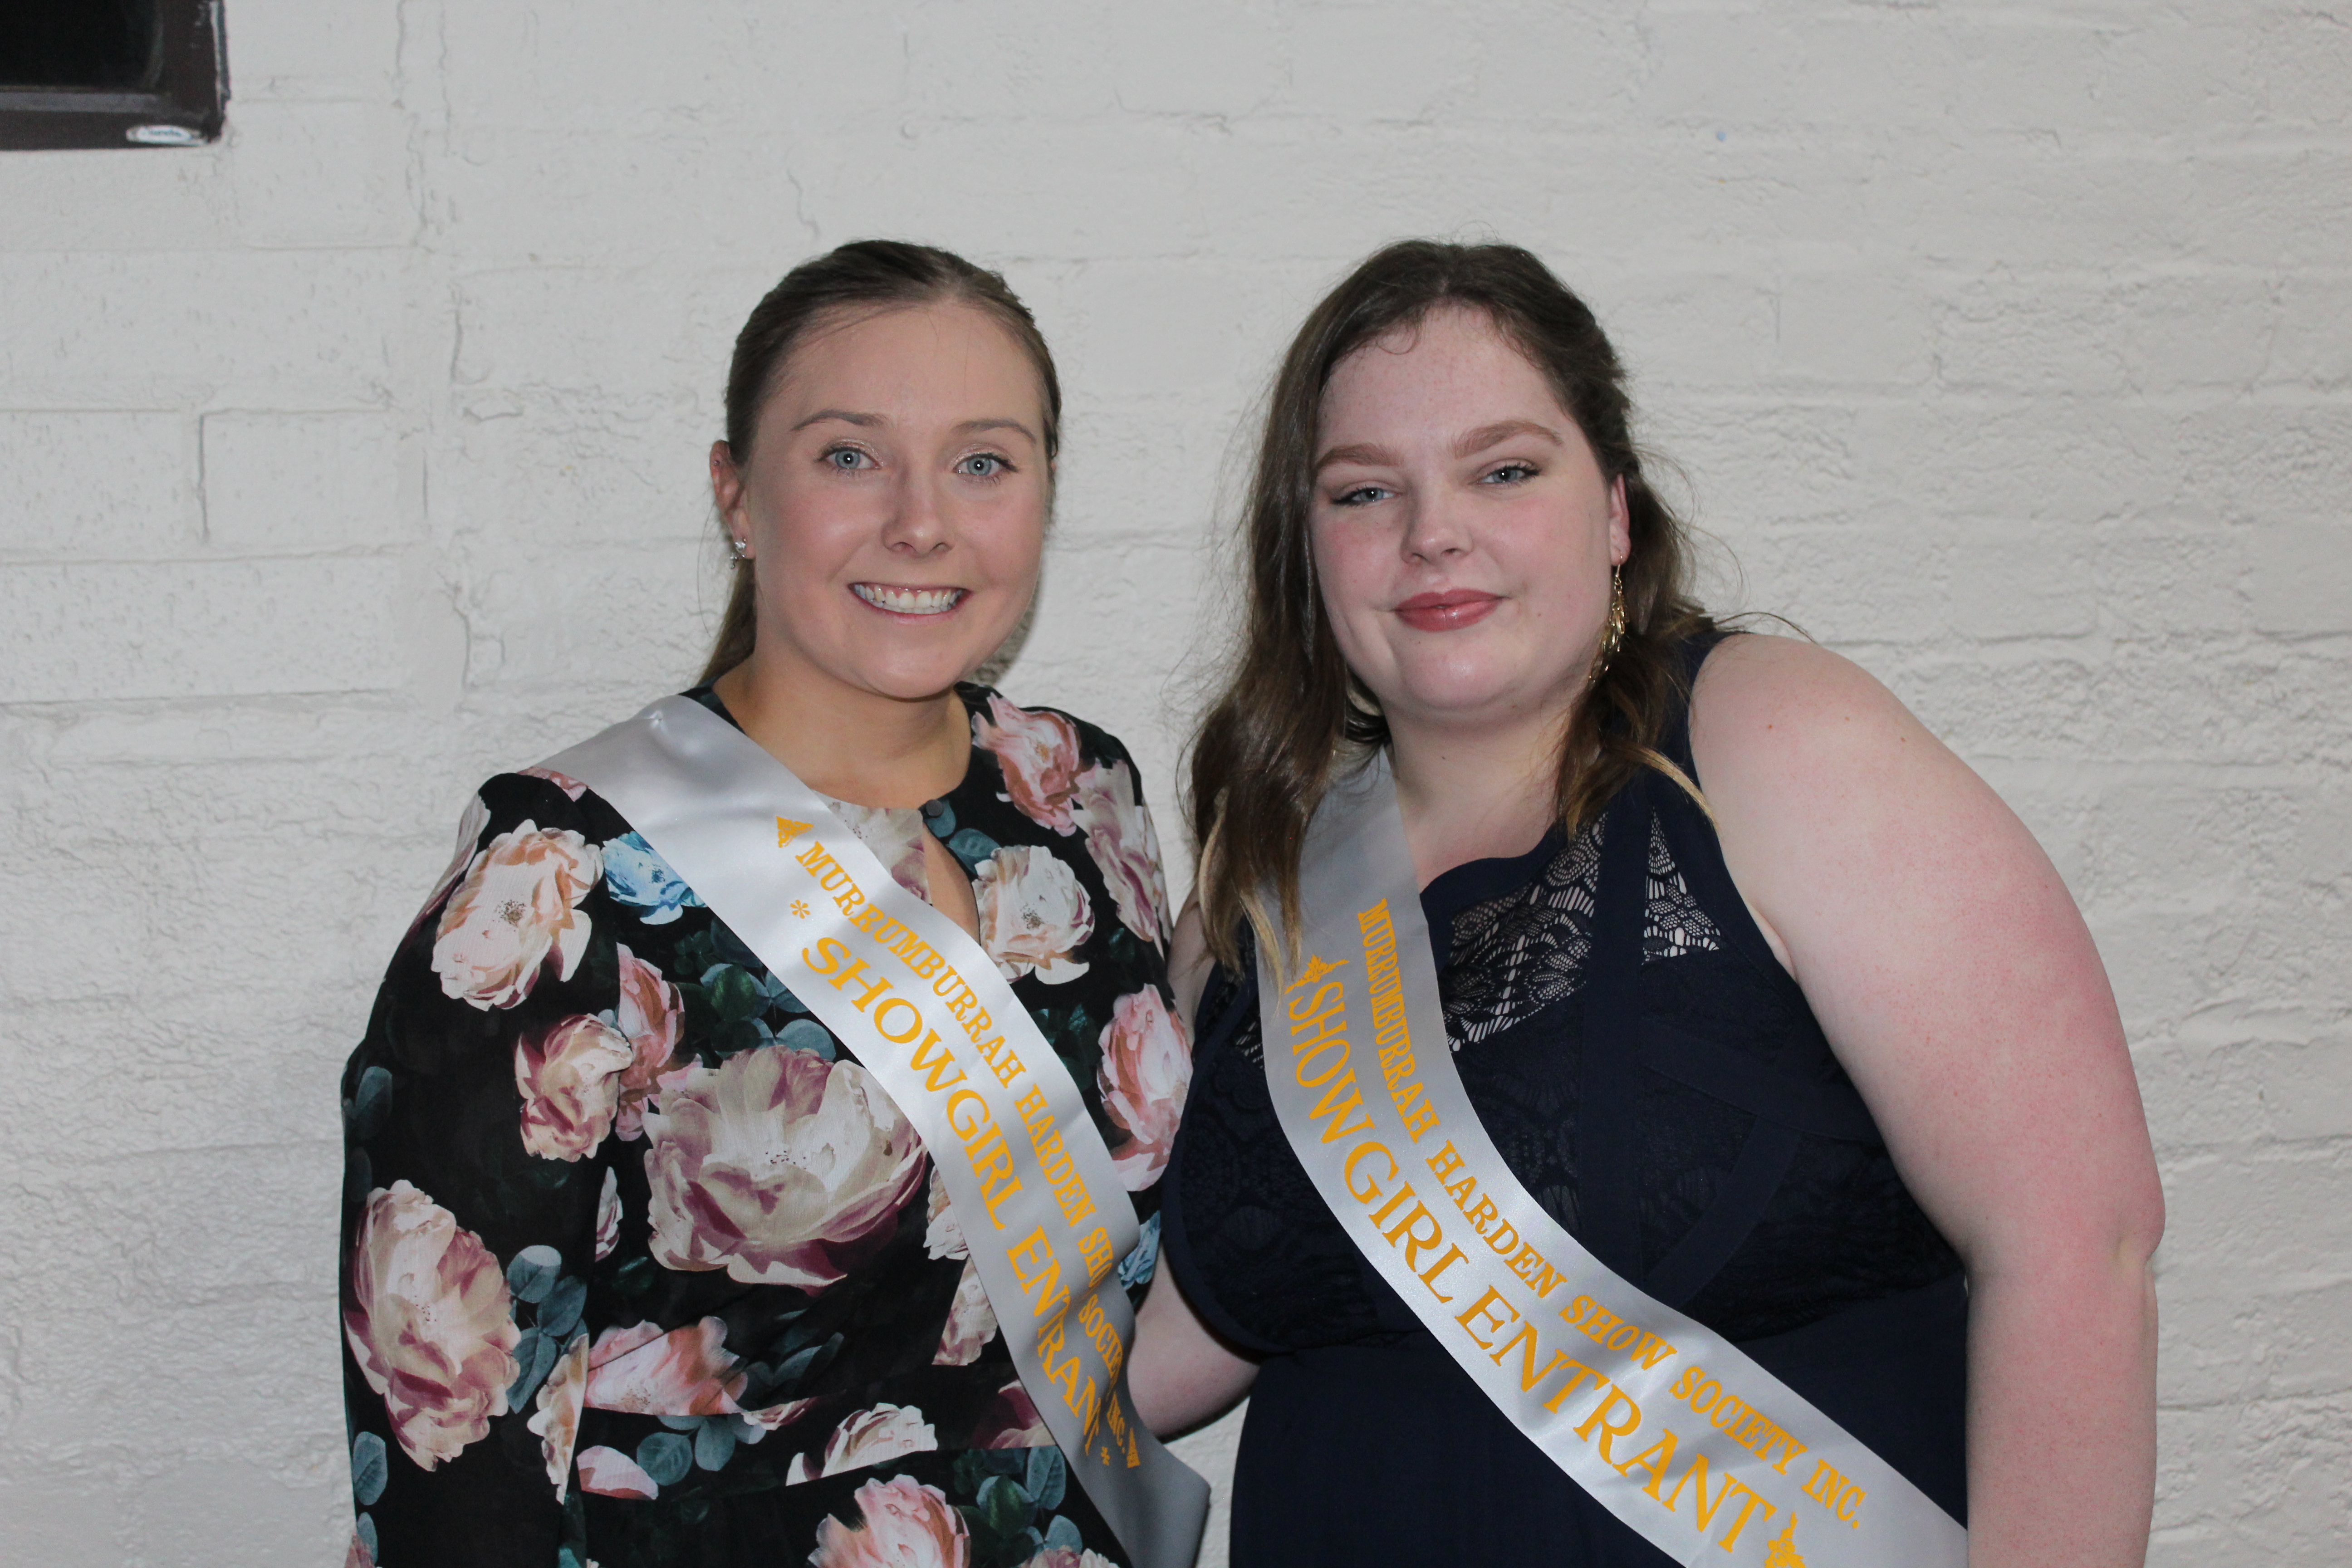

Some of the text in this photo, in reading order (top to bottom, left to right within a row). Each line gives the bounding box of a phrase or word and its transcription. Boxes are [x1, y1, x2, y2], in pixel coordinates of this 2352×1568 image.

[795, 841, 1027, 1089] MURRUMBURRAH
[1014, 1084, 1096, 1227] HARDEN
[802, 937, 1024, 1230] SHOWGIRL
[1288, 980, 1777, 1553] SHOWGIRL ENTRANT
[1357, 898, 1867, 1529] MURRUMBURRAH HARDEN SHOW SOCIETY INC.
